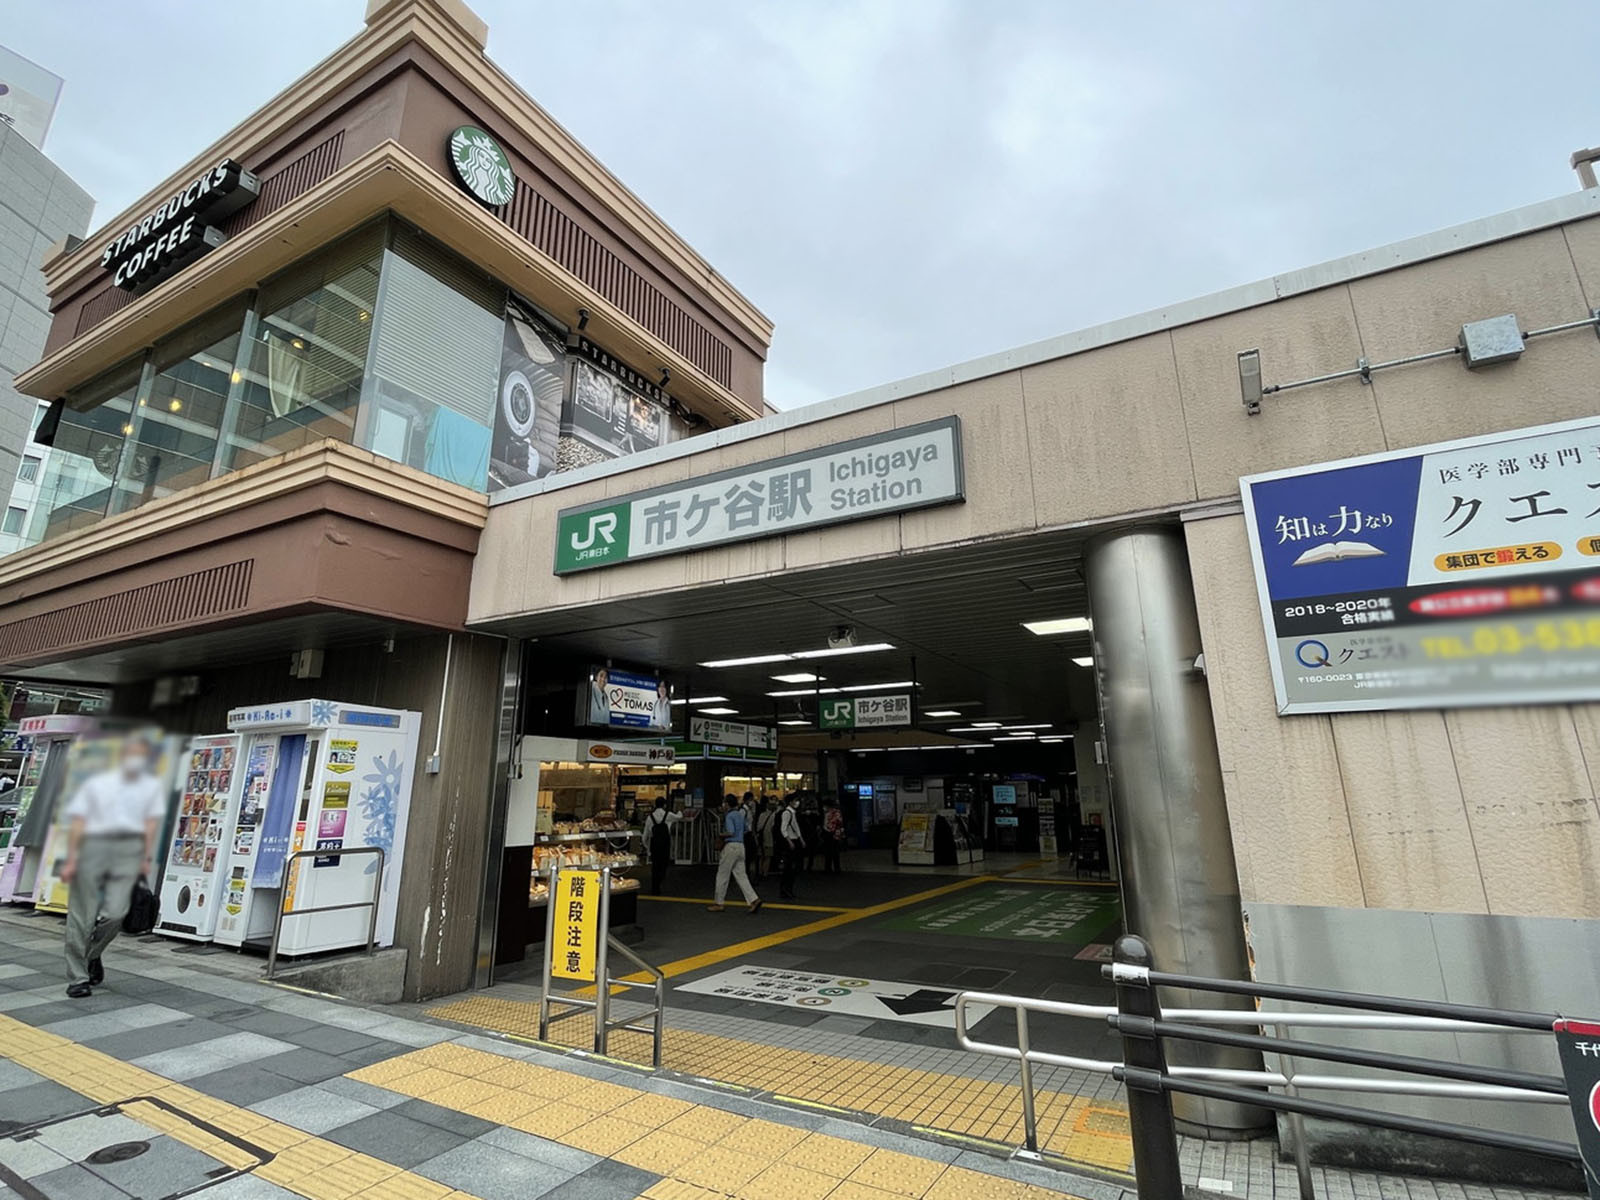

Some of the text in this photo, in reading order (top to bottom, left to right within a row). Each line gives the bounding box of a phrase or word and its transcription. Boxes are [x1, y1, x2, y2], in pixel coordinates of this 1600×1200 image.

[101, 158, 229, 267] STARBUCKS
[114, 215, 195, 287] COFFEE
[829, 441, 939, 484] Ichigaya
[643, 468, 812, 546] 市ケ谷駅
[830, 474, 922, 512] Station
[571, 512, 617, 550] JR
[1275, 505, 1393, 545] 知は力なり
[575, 547, 610, 561] JR東日本
[1445, 545, 1549, 569] 集団で鍛える
[623, 698, 654, 712] TOMAS
[824, 698, 908, 720] JR 市ケ谷駅
[858, 714, 908, 724] Ichigaya Station
[565, 876, 586, 973] 階段注意
